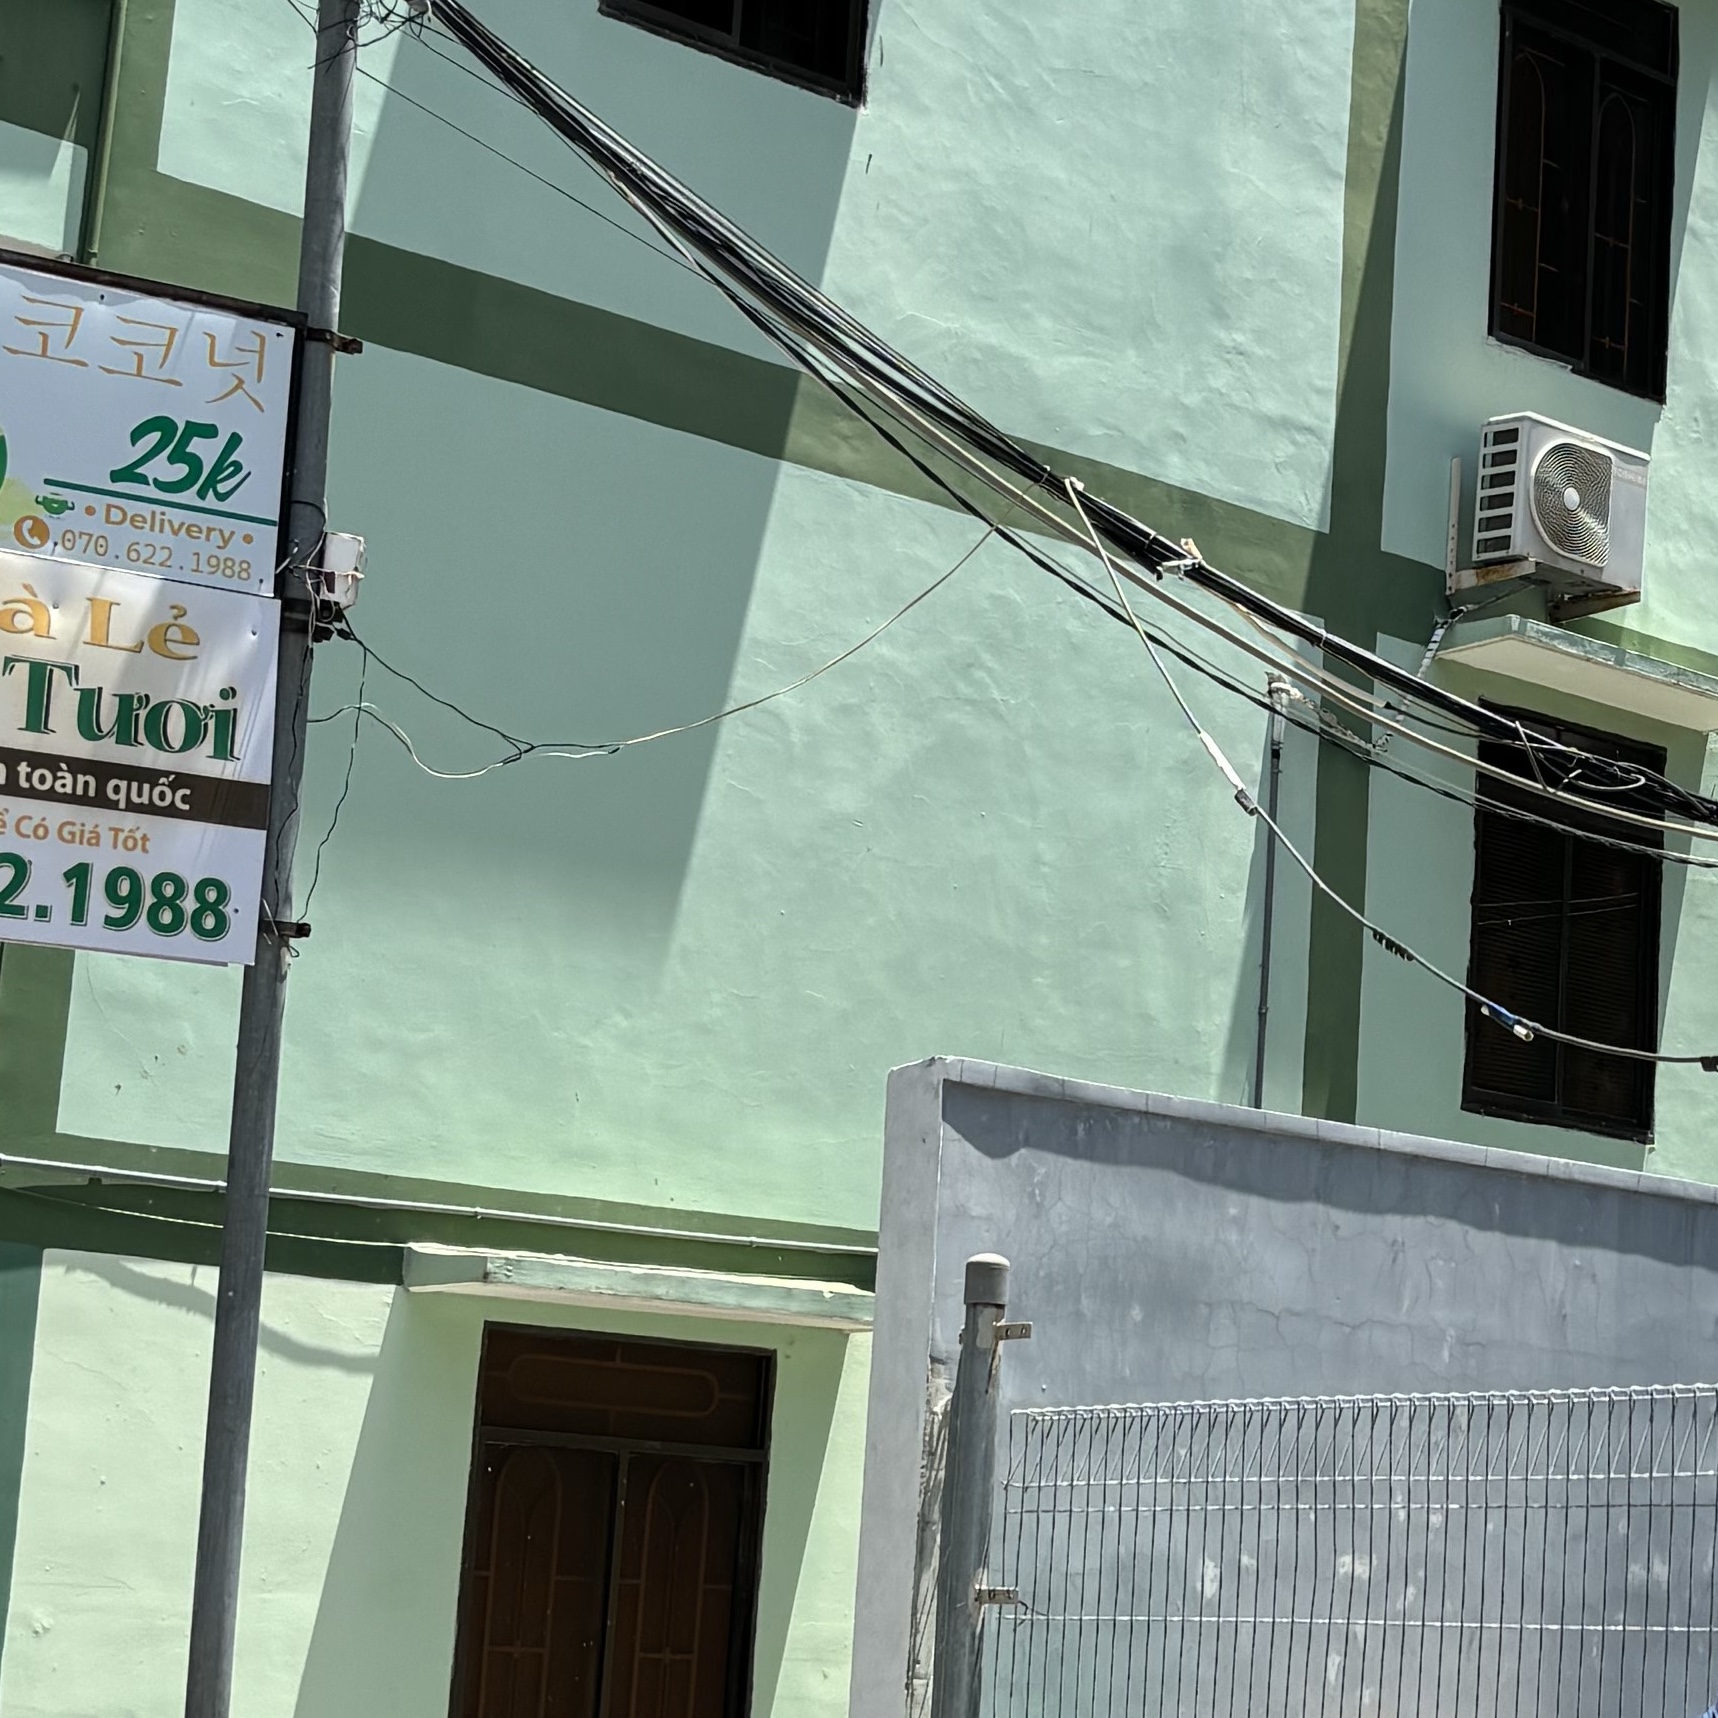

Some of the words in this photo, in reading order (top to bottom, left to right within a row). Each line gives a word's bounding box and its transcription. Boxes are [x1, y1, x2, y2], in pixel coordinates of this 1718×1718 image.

[2, 295, 266, 413] 코코넛
[109, 415, 251, 502] 25k
[60, 529, 252, 581] 070.622.1988
[103, 503, 236, 550] Delivery
[83, 596, 200, 661] Lẻ
[2, 655, 241, 763] Tươi
[16, 761, 97, 798] toàn
[105, 774, 191, 811] quốc
[14, 814, 50, 841] Có
[56, 820, 101, 848] Giá
[108, 826, 151, 854] Tốt
[0, 852, 232, 942] 2.1988
